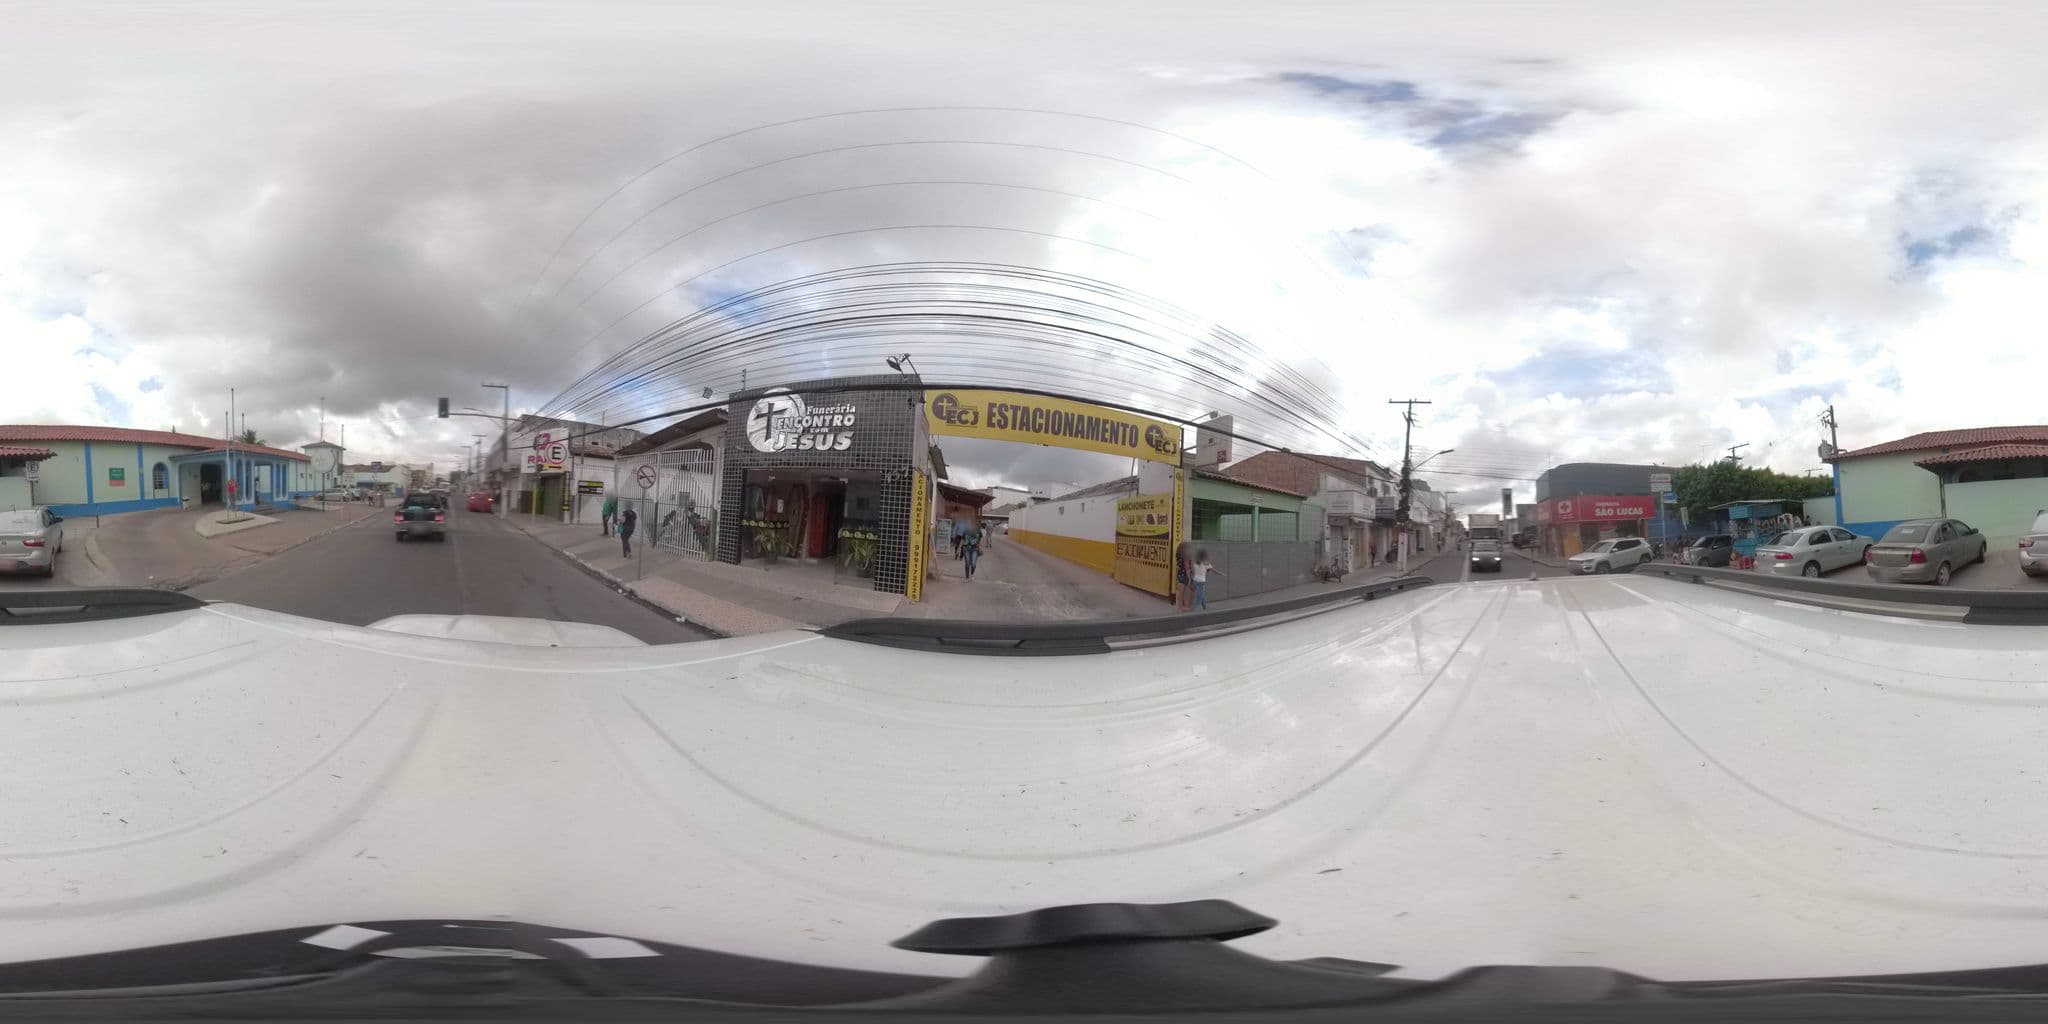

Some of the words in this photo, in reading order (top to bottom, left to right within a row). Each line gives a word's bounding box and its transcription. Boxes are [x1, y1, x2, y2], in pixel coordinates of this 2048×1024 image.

[806, 403, 856, 415] Funerária
[777, 413, 856, 430] ENCONTRO
[946, 409, 979, 426] ECJ
[986, 402, 1139, 448] ESTACIONAMENTO
[1155, 439, 1178, 455] ECJ
[773, 431, 855, 451] JESUS
[552, 446, 562, 460] E
[1617, 507, 1643, 516] LUCAS
